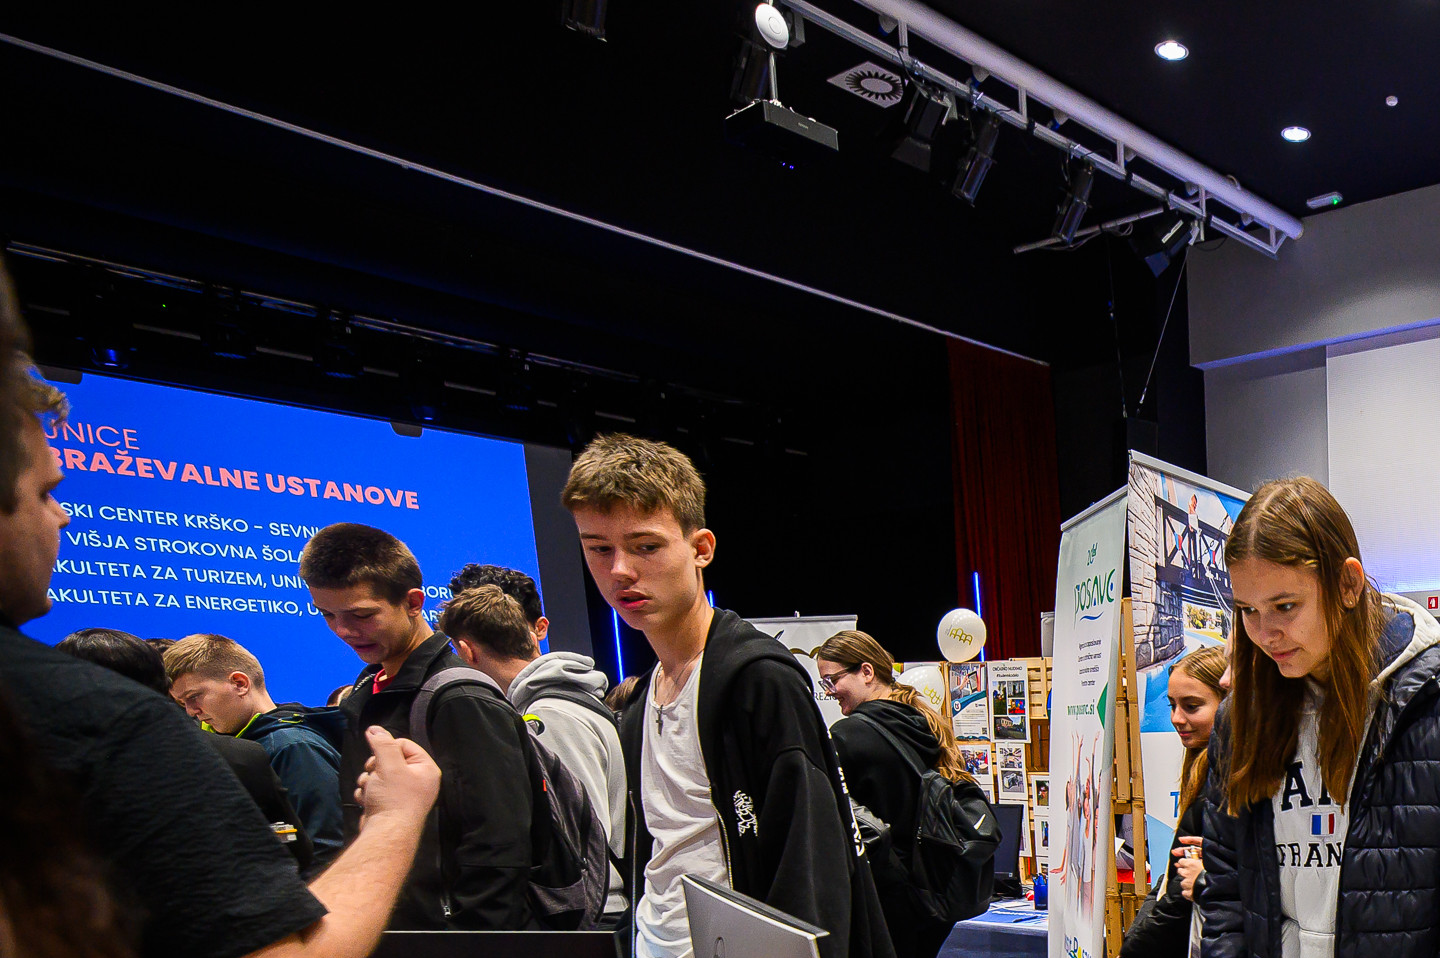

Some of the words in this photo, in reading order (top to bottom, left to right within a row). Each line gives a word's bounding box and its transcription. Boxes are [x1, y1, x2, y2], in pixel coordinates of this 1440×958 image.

[265, 473, 420, 510] USTANOVE
[99, 505, 179, 527] CENTER
[183, 512, 249, 533] KRŠKO
[65, 530, 130, 550] VIŠJA
[134, 536, 258, 560] STROKOVNA
[151, 565, 179, 581] ZA
[182, 567, 267, 589] TURIZEM,
[153, 593, 181, 609] ZA
[185, 595, 303, 617] ENERGETIKO,
